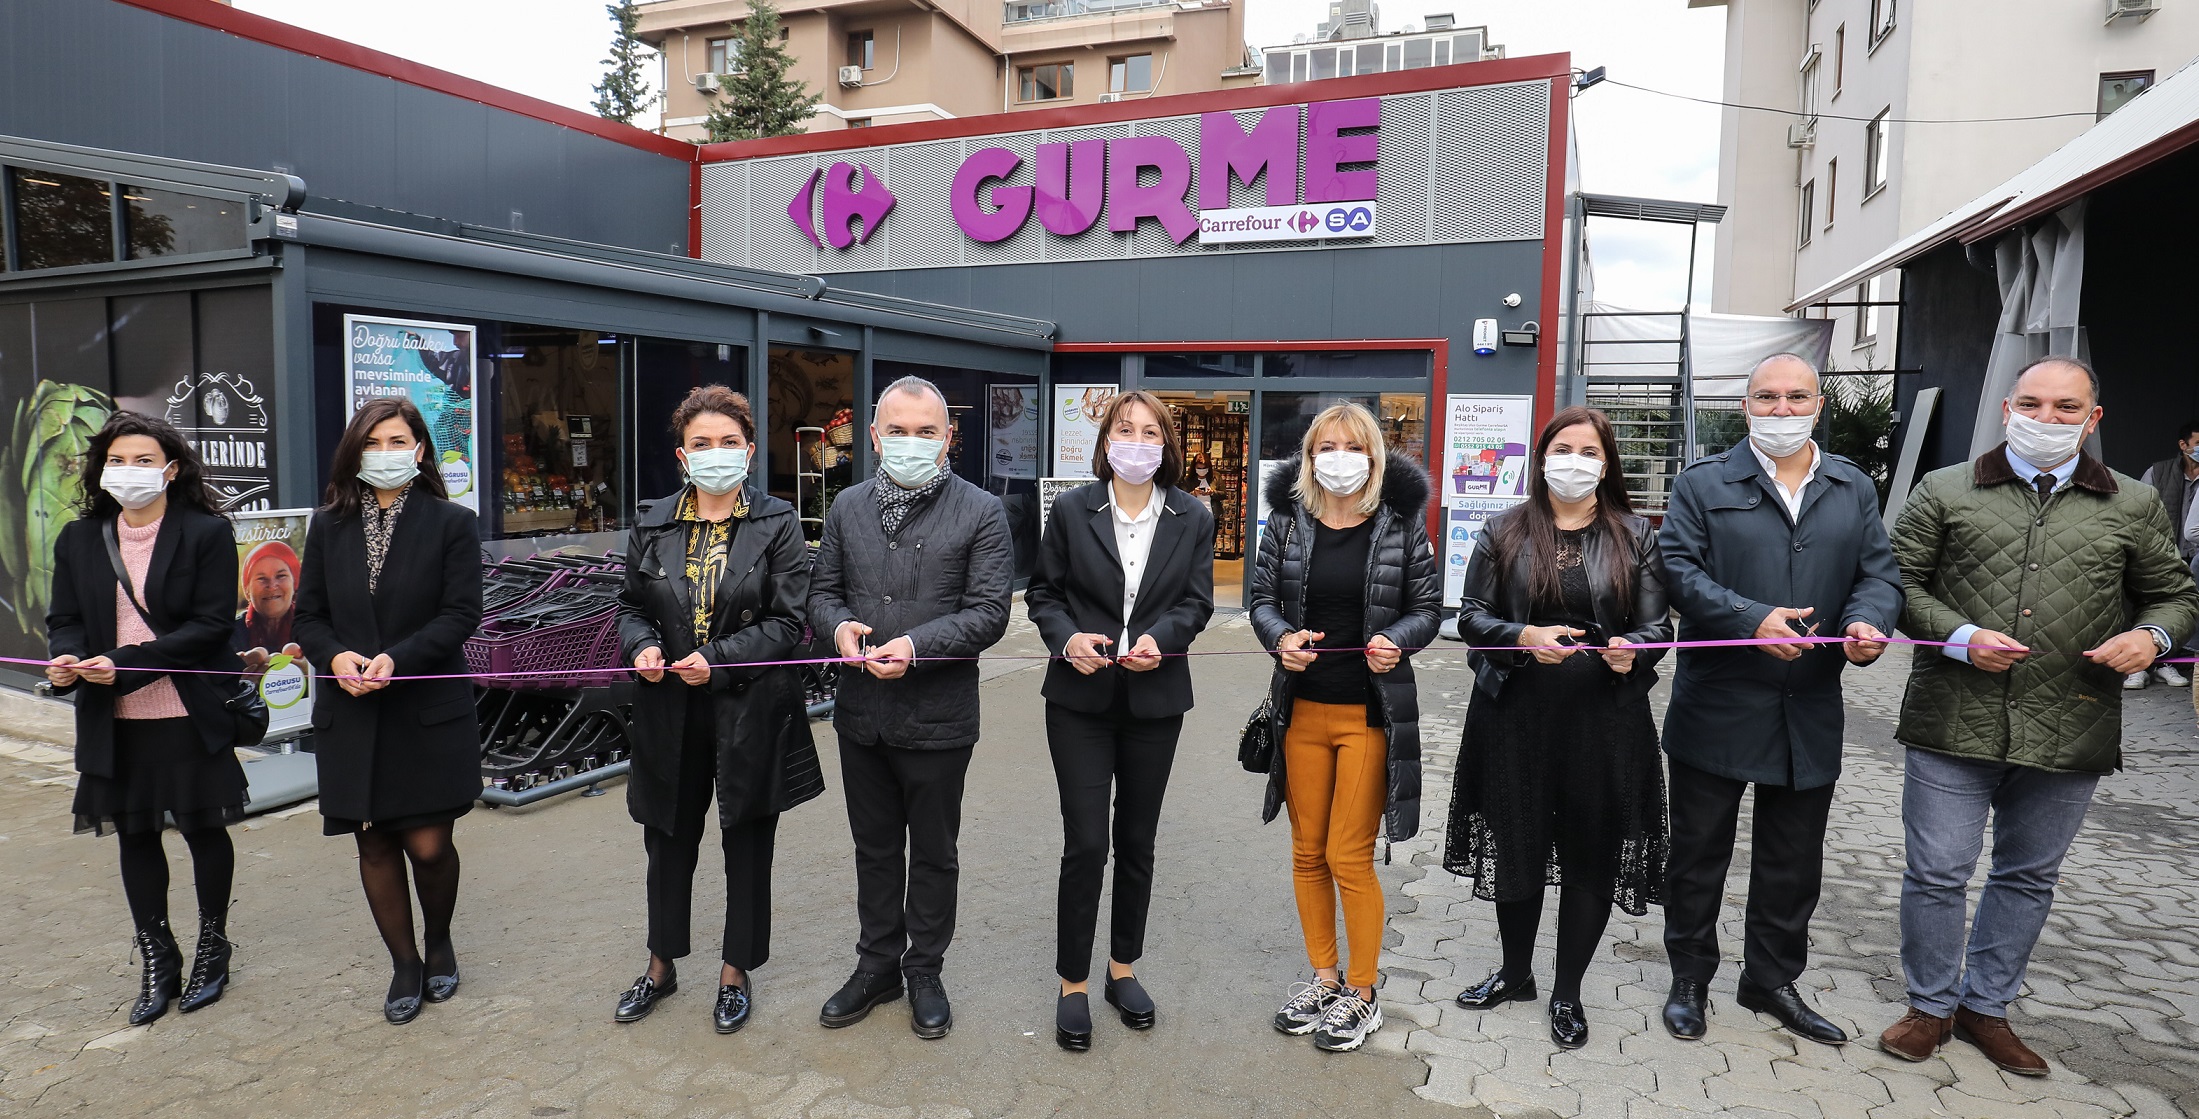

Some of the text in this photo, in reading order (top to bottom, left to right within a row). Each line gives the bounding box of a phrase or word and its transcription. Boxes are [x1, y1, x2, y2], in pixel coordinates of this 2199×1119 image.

[951, 98, 1380, 246] GURME
[1199, 210, 1370, 233] Carrefour SA
[353, 325, 446, 354] Doğru balıkçı
[354, 352, 396, 365] varsa
[355, 369, 431, 383] mevsiminde
[355, 383, 406, 396] avlanan
[1455, 404, 1504, 414] Alo Sipariş
[1454, 414, 1478, 422] Hattı
[1060, 429, 1083, 437] Lezzet
[1060, 437, 1093, 445] Fırınından
[187, 434, 267, 468] LERİNDE
[1060, 445, 1083, 454] Doğru
[1060, 453, 1084, 461] Ekmek
[1458, 500, 1504, 510] Sağlığınız
[235, 523, 291, 544] tiştirici
[265, 677, 301, 689] DOĞRUSU
